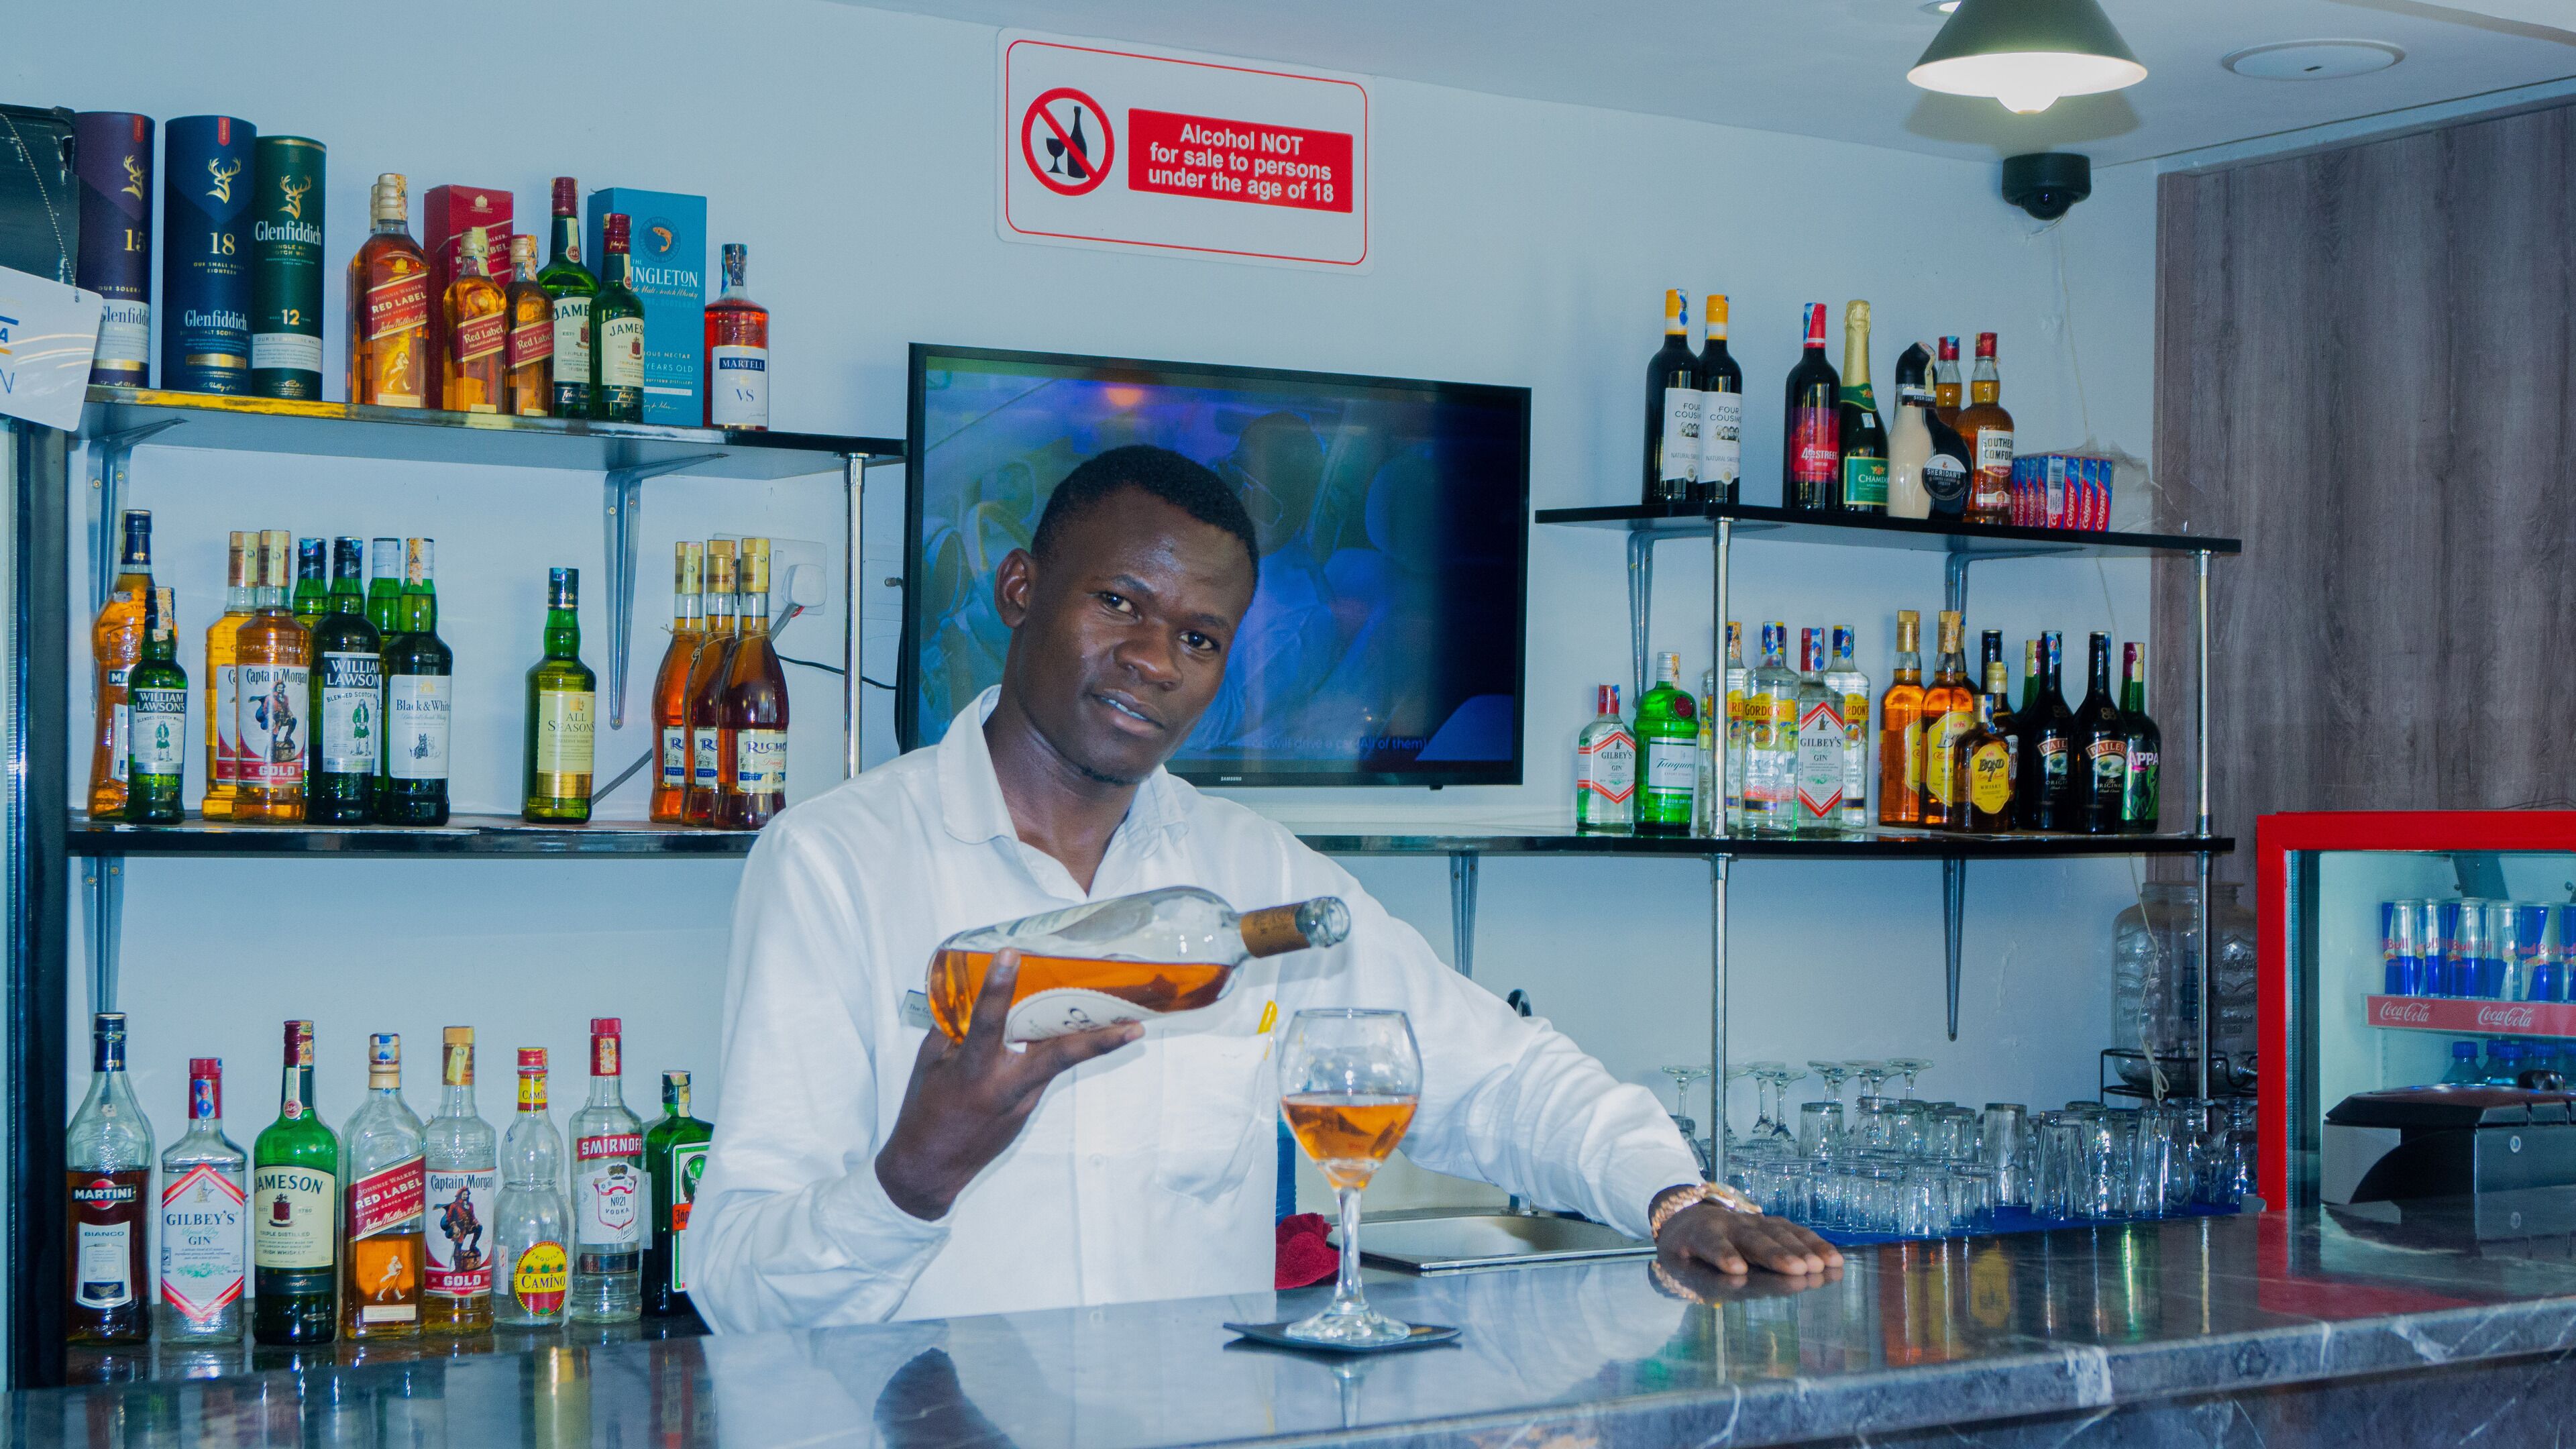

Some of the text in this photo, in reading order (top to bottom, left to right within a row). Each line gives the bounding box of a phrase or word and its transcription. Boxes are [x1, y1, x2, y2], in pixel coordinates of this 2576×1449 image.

[1180, 123, 1303, 156] Alcohol NOT
[1150, 142, 1332, 180] for sale to persons
[1148, 167, 1334, 203] under the age of 18
[255, 220, 321, 246] Glenfiddich
[209, 231, 235, 255] 18
[631, 266, 698, 288] INGLETON
[372, 291, 427, 314] RED LABEL
[281, 309, 301, 325] 12
[553, 304, 589, 321] JAME
[185, 309, 248, 331] Glenfiddich
[464, 324, 504, 343] Red Label
[609, 323, 645, 336] JAMES
[517, 332, 553, 350] Red Label
[646, 363, 673, 372] YEARS
[676, 364, 693, 373] OLD
[722, 359, 763, 369] MARTELL
[736, 388, 754, 402] VS
[1719, 406, 1739, 414] FOUR
[1984, 437, 2012, 447] SOUTHER
[1816, 449, 1837, 460] STREET
[1984, 449, 2012, 460] COMFOR
[1858, 474, 1889, 483] CHAMDO
[1927, 468, 1961, 479] SHERIDAN'S
[2066, 486, 2075, 527] Colgate
[2082, 488, 2092, 529] Colgate
[2096, 489, 2106, 531] Colgate
[280, 668, 307, 686] Morgan
[327, 673, 379, 686] LAWSON
[140, 692, 184, 702] WILLIAM
[137, 702, 185, 712] LAWSON'S
[423, 699, 431, 711] &
[431, 699, 451, 712] White
[1845, 705, 1869, 716] RDON'S
[566, 712, 586, 722] ALL
[745, 741, 787, 754] RICHO
[1377, 737, 1391, 749] of
[1392, 736, 1428, 751] them)
[1800, 736, 1841, 747] GILBEY'S
[2041, 738, 2068, 753] BAIL
[1601, 750, 1632, 759] GILBEY'S
[2127, 752, 2159, 766] APPA
[259, 765, 295, 776] GOLD
[1978, 759, 2005, 771] BOND
[1987, 767, 1996, 782] 7
[2387, 938, 2408, 949] Bull
[2452, 939, 2473, 951] Bull
[2380, 1001, 2431, 1022] Coca-Cola
[2477, 1005, 2534, 1027] Coca-Cola
[254, 1174, 323, 1195] JAMESON
[358, 1181, 388, 1197] JOHNNIE
[431, 1174, 493, 1192] Captain Morgan
[74, 1187, 132, 1199] MARTINI
[356, 1177, 423, 1210] RED LABEL
[166, 1210, 235, 1226] GILBEY'S
[189, 1236, 211, 1246] GIN
[531, 1251, 560, 1261] TEQUILA
[443, 1275, 482, 1287] GOLD
